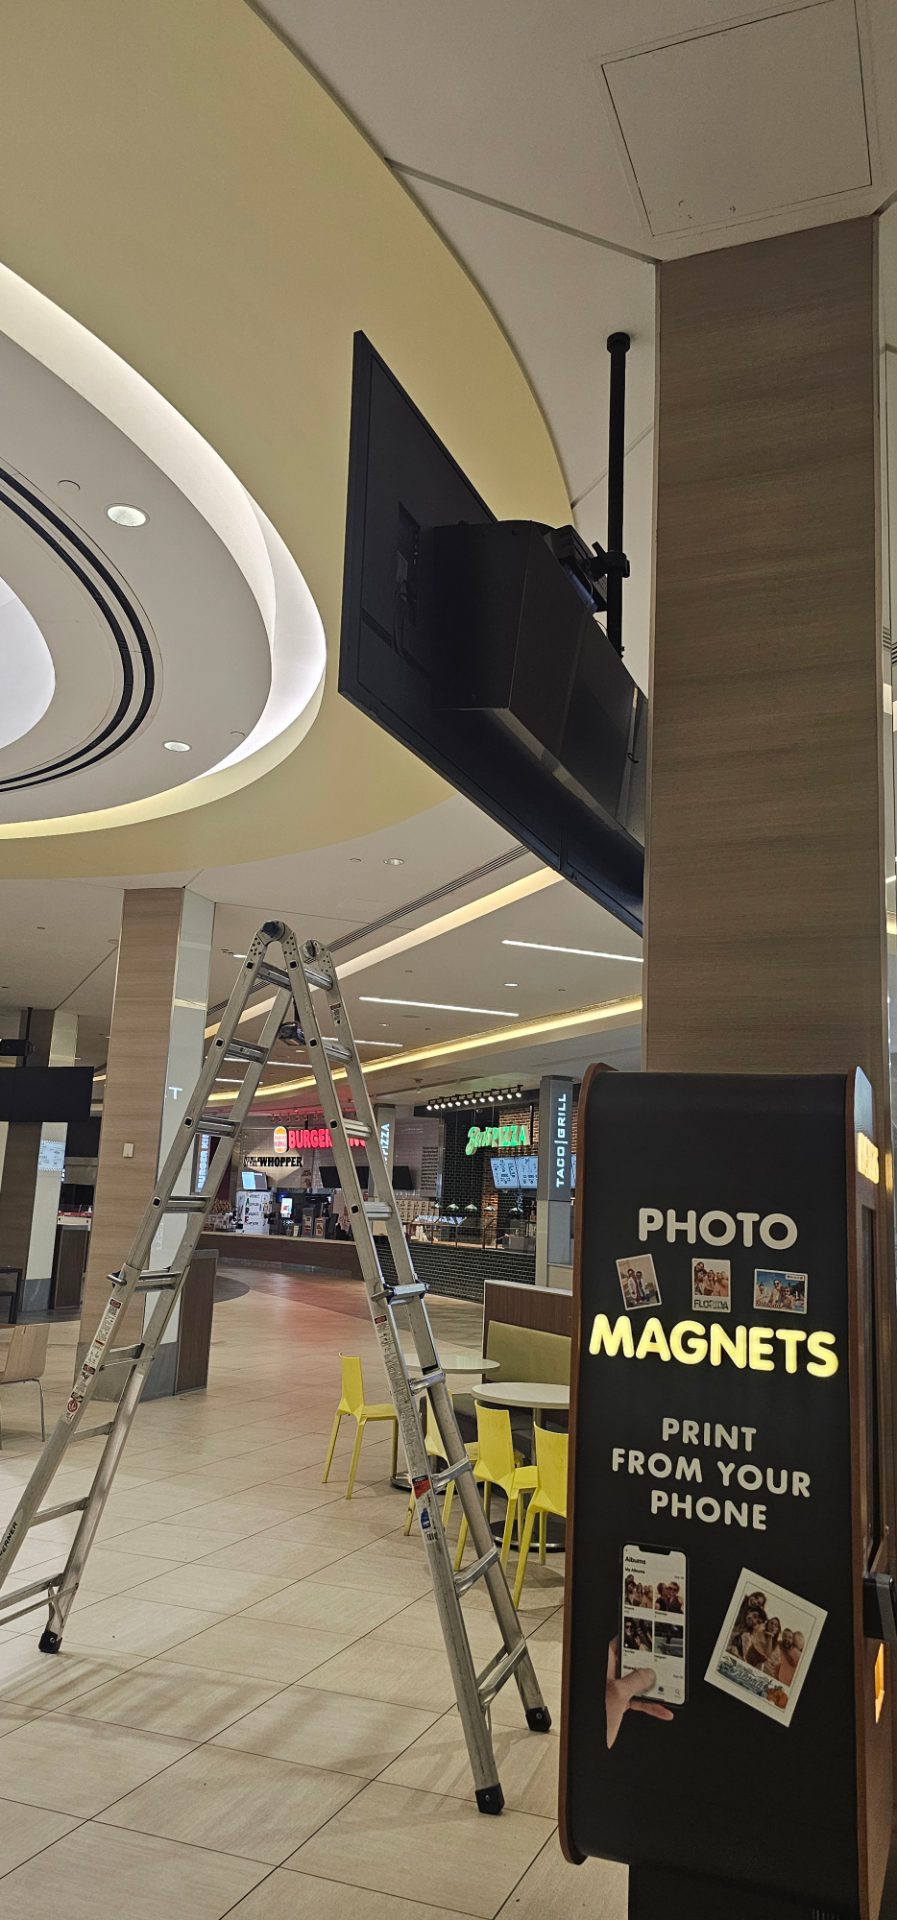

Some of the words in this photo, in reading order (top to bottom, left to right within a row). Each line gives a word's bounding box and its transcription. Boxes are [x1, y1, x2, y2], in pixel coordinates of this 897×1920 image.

[259, 1156, 303, 1168] WHOPPER
[638, 1207, 798, 1250] PHOTO
[588, 1313, 839, 1378] MAGNETS
[662, 1417, 757, 1452] PRINT
[612, 1447, 703, 1483] FROM
[717, 1460, 811, 1498] YOUR
[651, 1489, 768, 1531] PHONE
